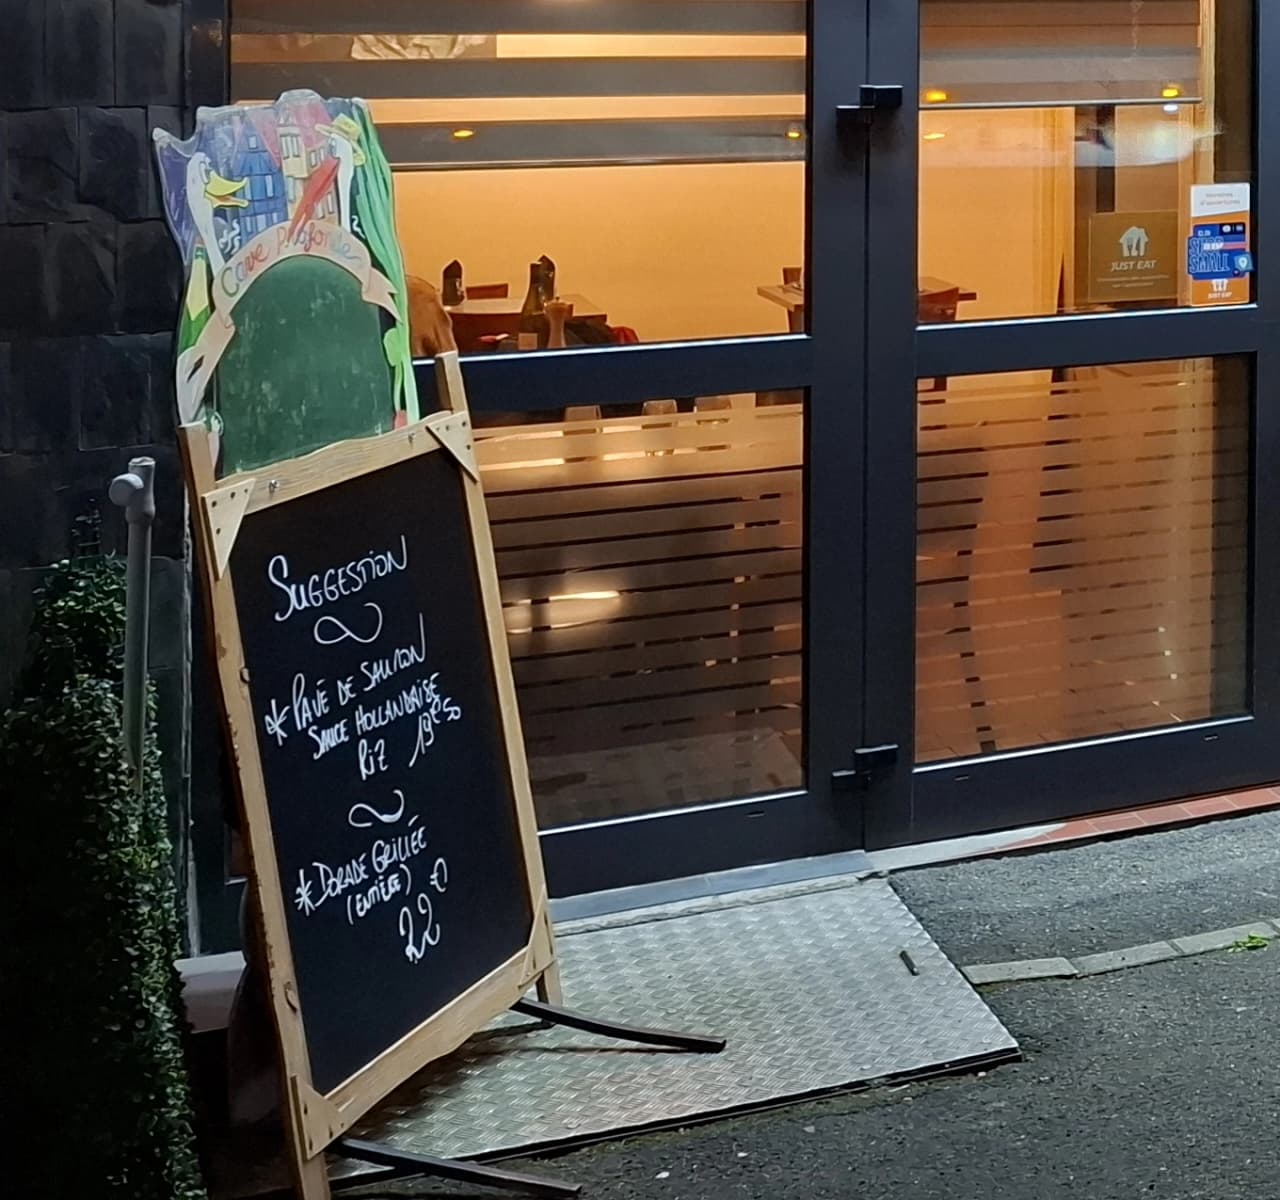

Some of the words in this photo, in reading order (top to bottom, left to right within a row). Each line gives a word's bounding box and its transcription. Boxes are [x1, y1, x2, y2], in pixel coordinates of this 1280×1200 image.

[221, 243, 269, 297] Cave
[1111, 261, 1135, 272] JUST
[1137, 260, 1157, 270] EAT
